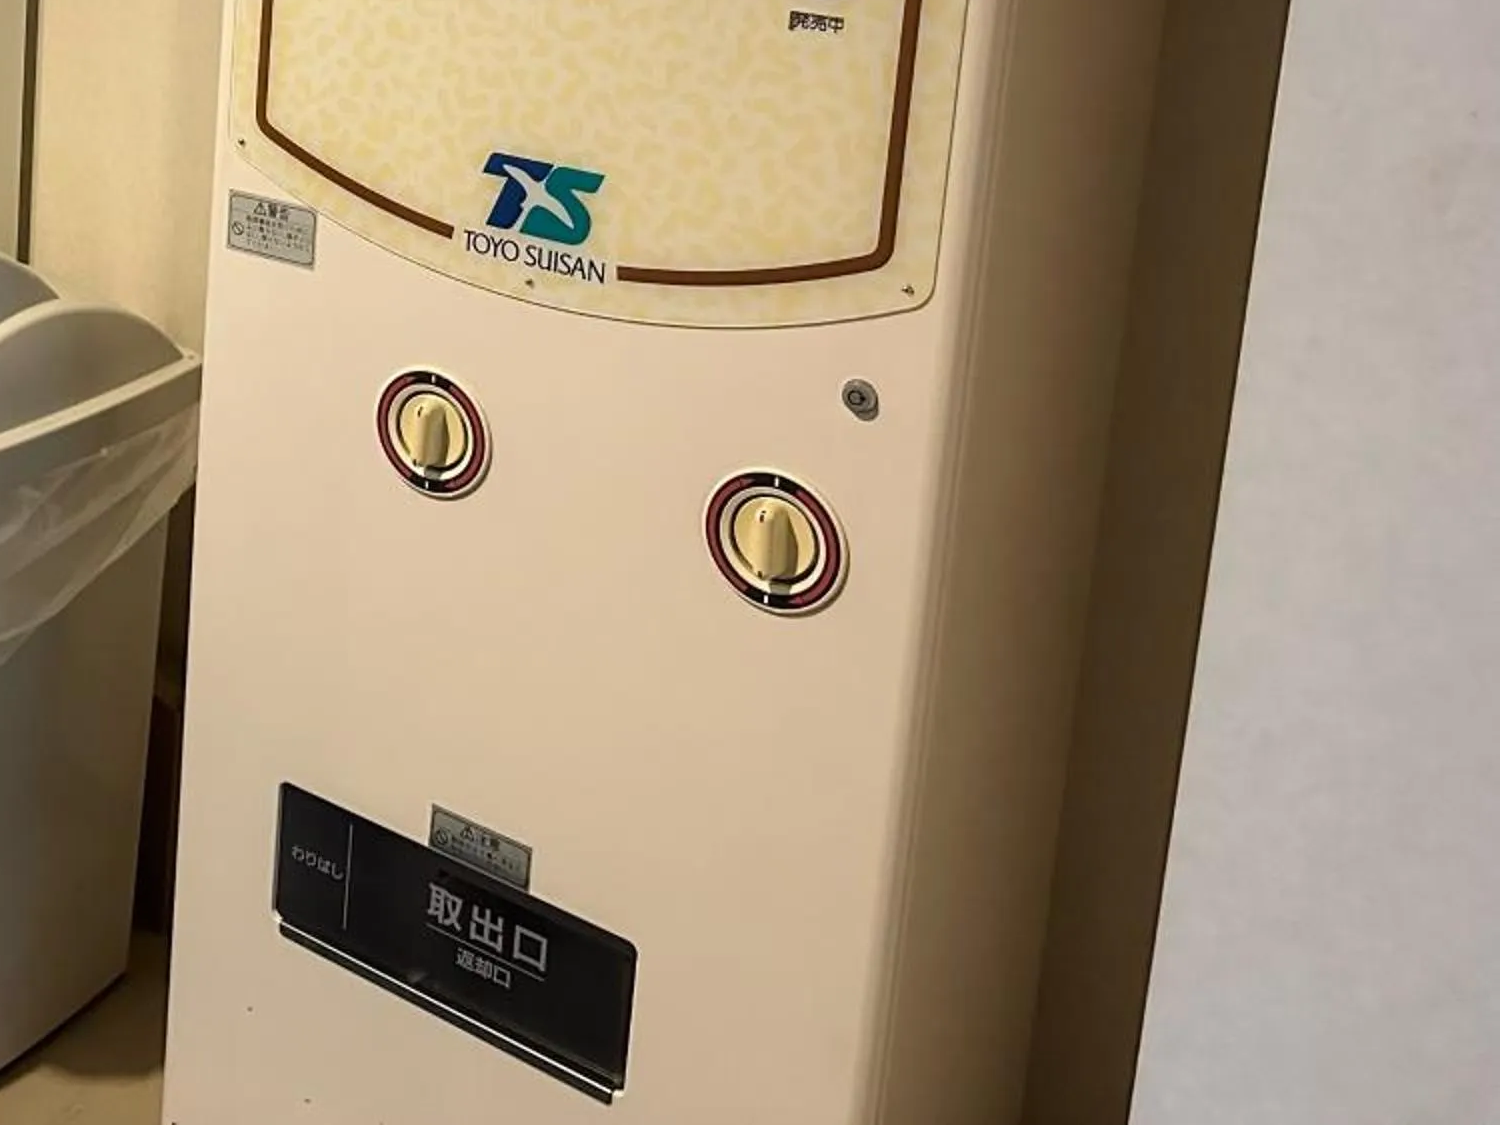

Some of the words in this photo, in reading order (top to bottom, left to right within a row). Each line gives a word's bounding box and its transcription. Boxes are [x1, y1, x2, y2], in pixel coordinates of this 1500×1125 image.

[464, 229, 520, 262] TOYO
[523, 244, 606, 284] SUISAN
[290, 843, 346, 881] わりばし
[427, 881, 548, 973] 取出口
[454, 946, 513, 990] 返却口
